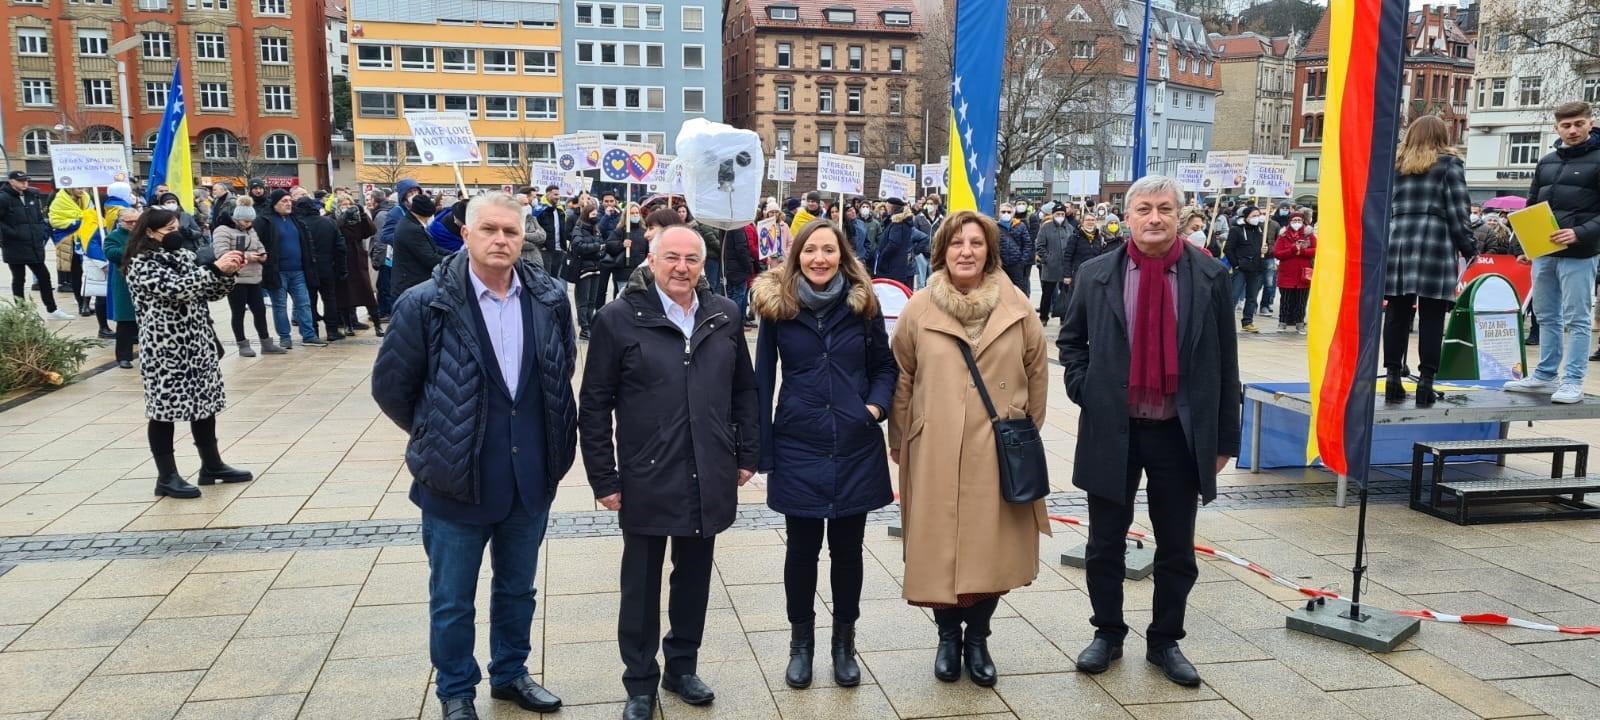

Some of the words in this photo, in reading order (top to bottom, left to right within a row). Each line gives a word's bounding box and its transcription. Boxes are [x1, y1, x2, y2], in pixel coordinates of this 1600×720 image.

[415, 126, 445, 136] MAKE
[447, 126, 472, 135] LOVE
[423, 137, 443, 146] NOT
[447, 136, 473, 145] WAR!
[826, 160, 854, 170] FRIEDEN
[1477, 257, 1495, 265] SKA
